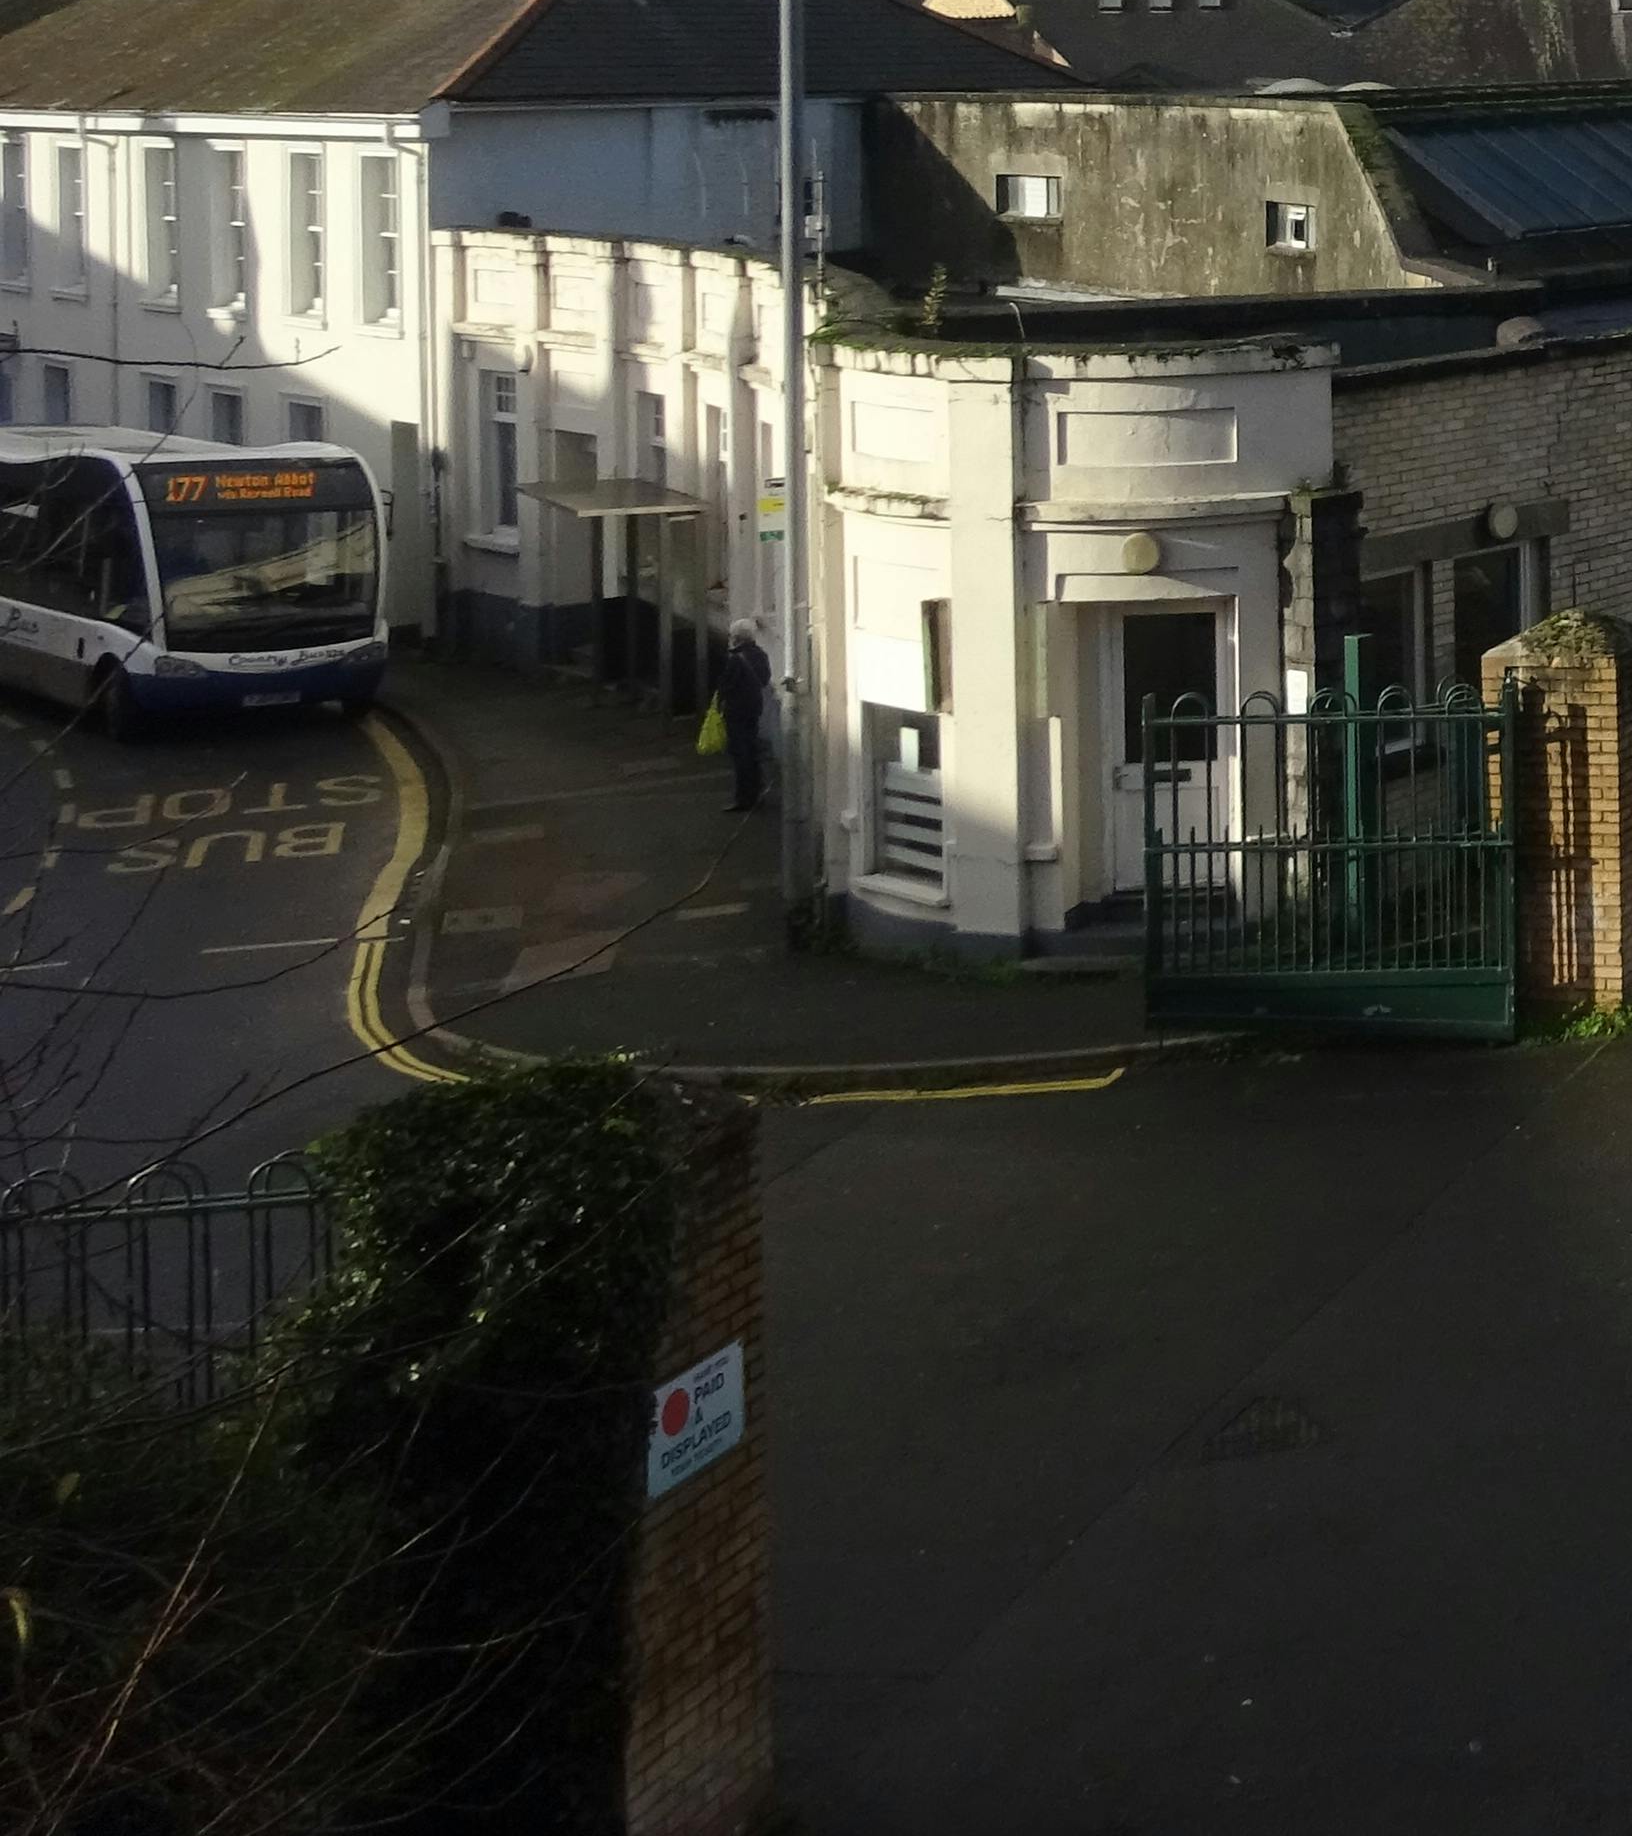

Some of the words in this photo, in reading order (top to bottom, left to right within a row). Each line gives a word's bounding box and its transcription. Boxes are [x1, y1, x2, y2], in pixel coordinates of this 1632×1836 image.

[166, 475, 209, 502] 177
[215, 474, 268, 488] Newton
[274, 471, 315, 485] Abbot
[78, 775, 384, 830] STOP
[107, 821, 347, 874] BUS
[694, 1372, 726, 1405] PAID
[661, 1410, 732, 1470] DISPLAYED
